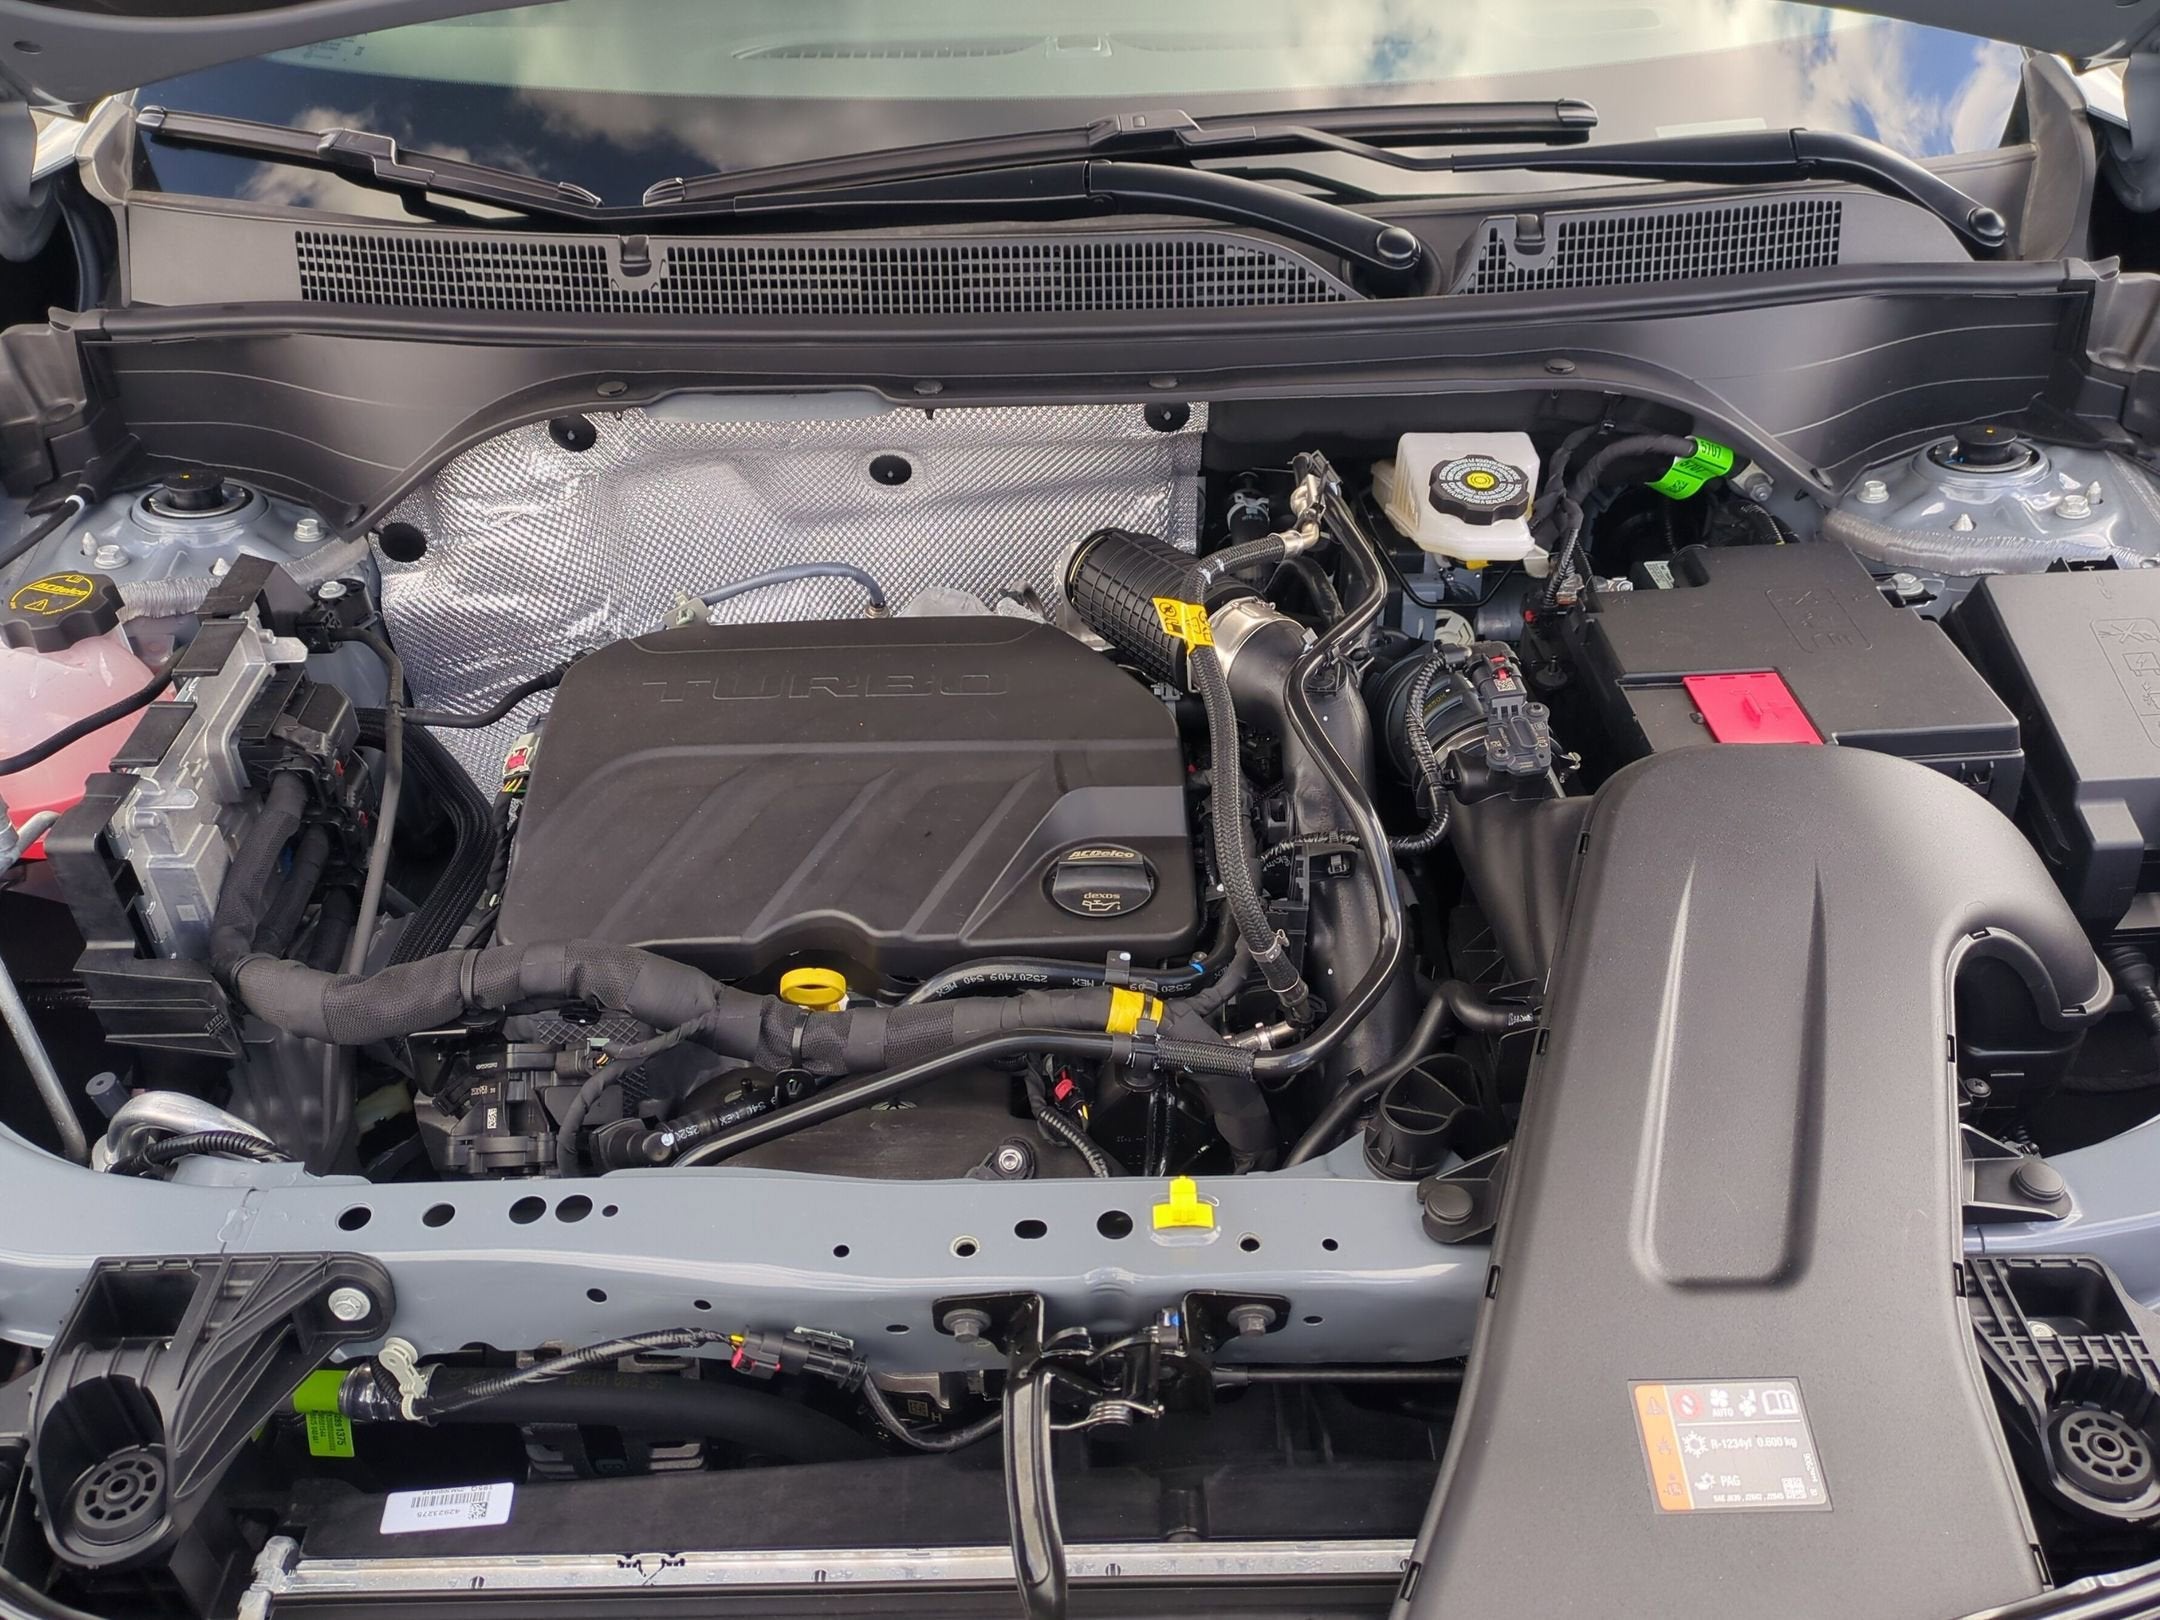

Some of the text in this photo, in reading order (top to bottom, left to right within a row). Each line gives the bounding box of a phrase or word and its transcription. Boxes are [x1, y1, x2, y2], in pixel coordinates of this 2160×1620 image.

[1701, 440, 1722, 459] 5707
[642, 673, 1008, 702] TURBO
[1067, 850, 1135, 860] ACDelco
[936, 973, 1048, 997] 25207409 540 MEX
[1072, 977, 1095, 987] MEX
[720, 1111, 740, 1126] MEX
[1712, 1408, 1734, 1417] AUTO
[1757, 1436, 1784, 1448] 0.600
[1784, 1436, 1797, 1448] kg
[1720, 1475, 1741, 1487] PAG
